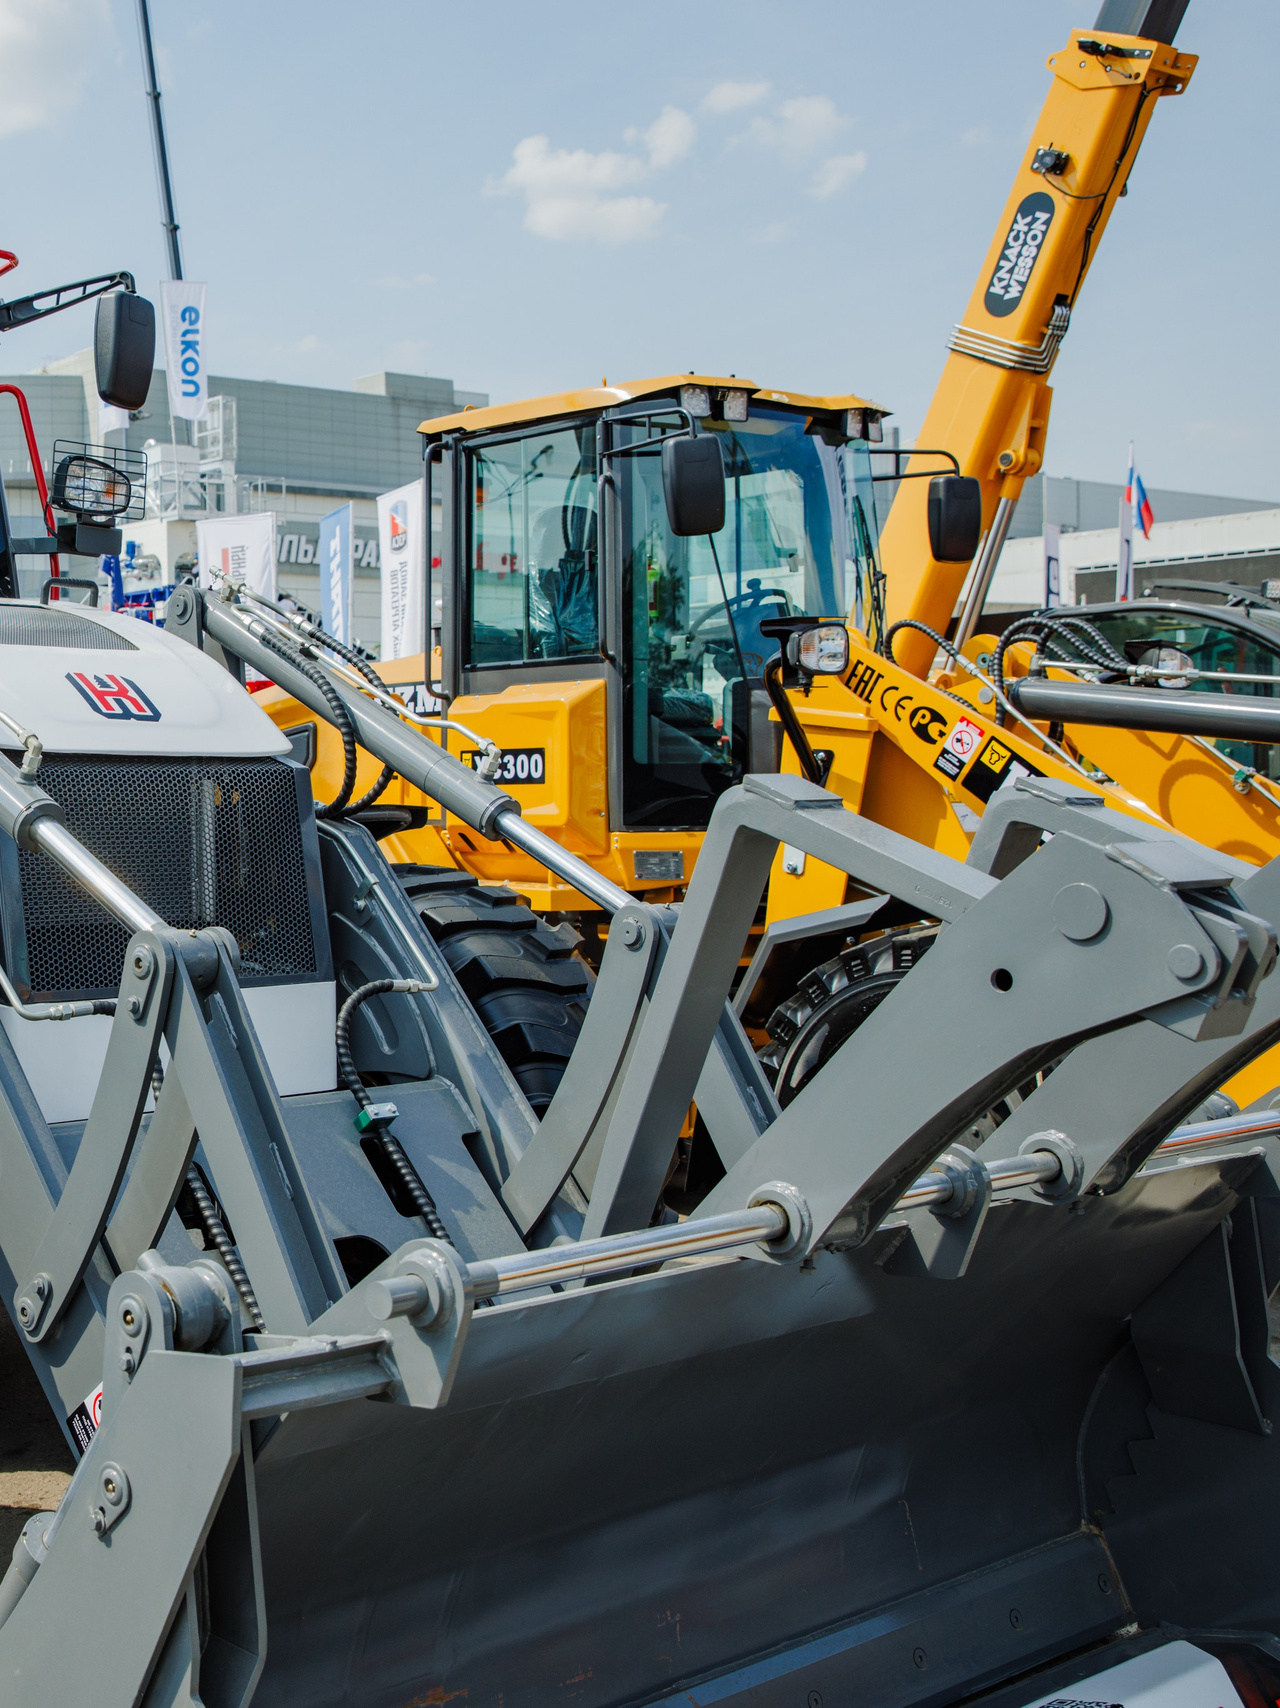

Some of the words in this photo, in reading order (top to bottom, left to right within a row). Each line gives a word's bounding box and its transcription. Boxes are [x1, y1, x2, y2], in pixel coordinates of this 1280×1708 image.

[989, 212, 1033, 295] KNACK
[1003, 211, 1051, 300] WESSON
[180, 305, 200, 397] elkon
